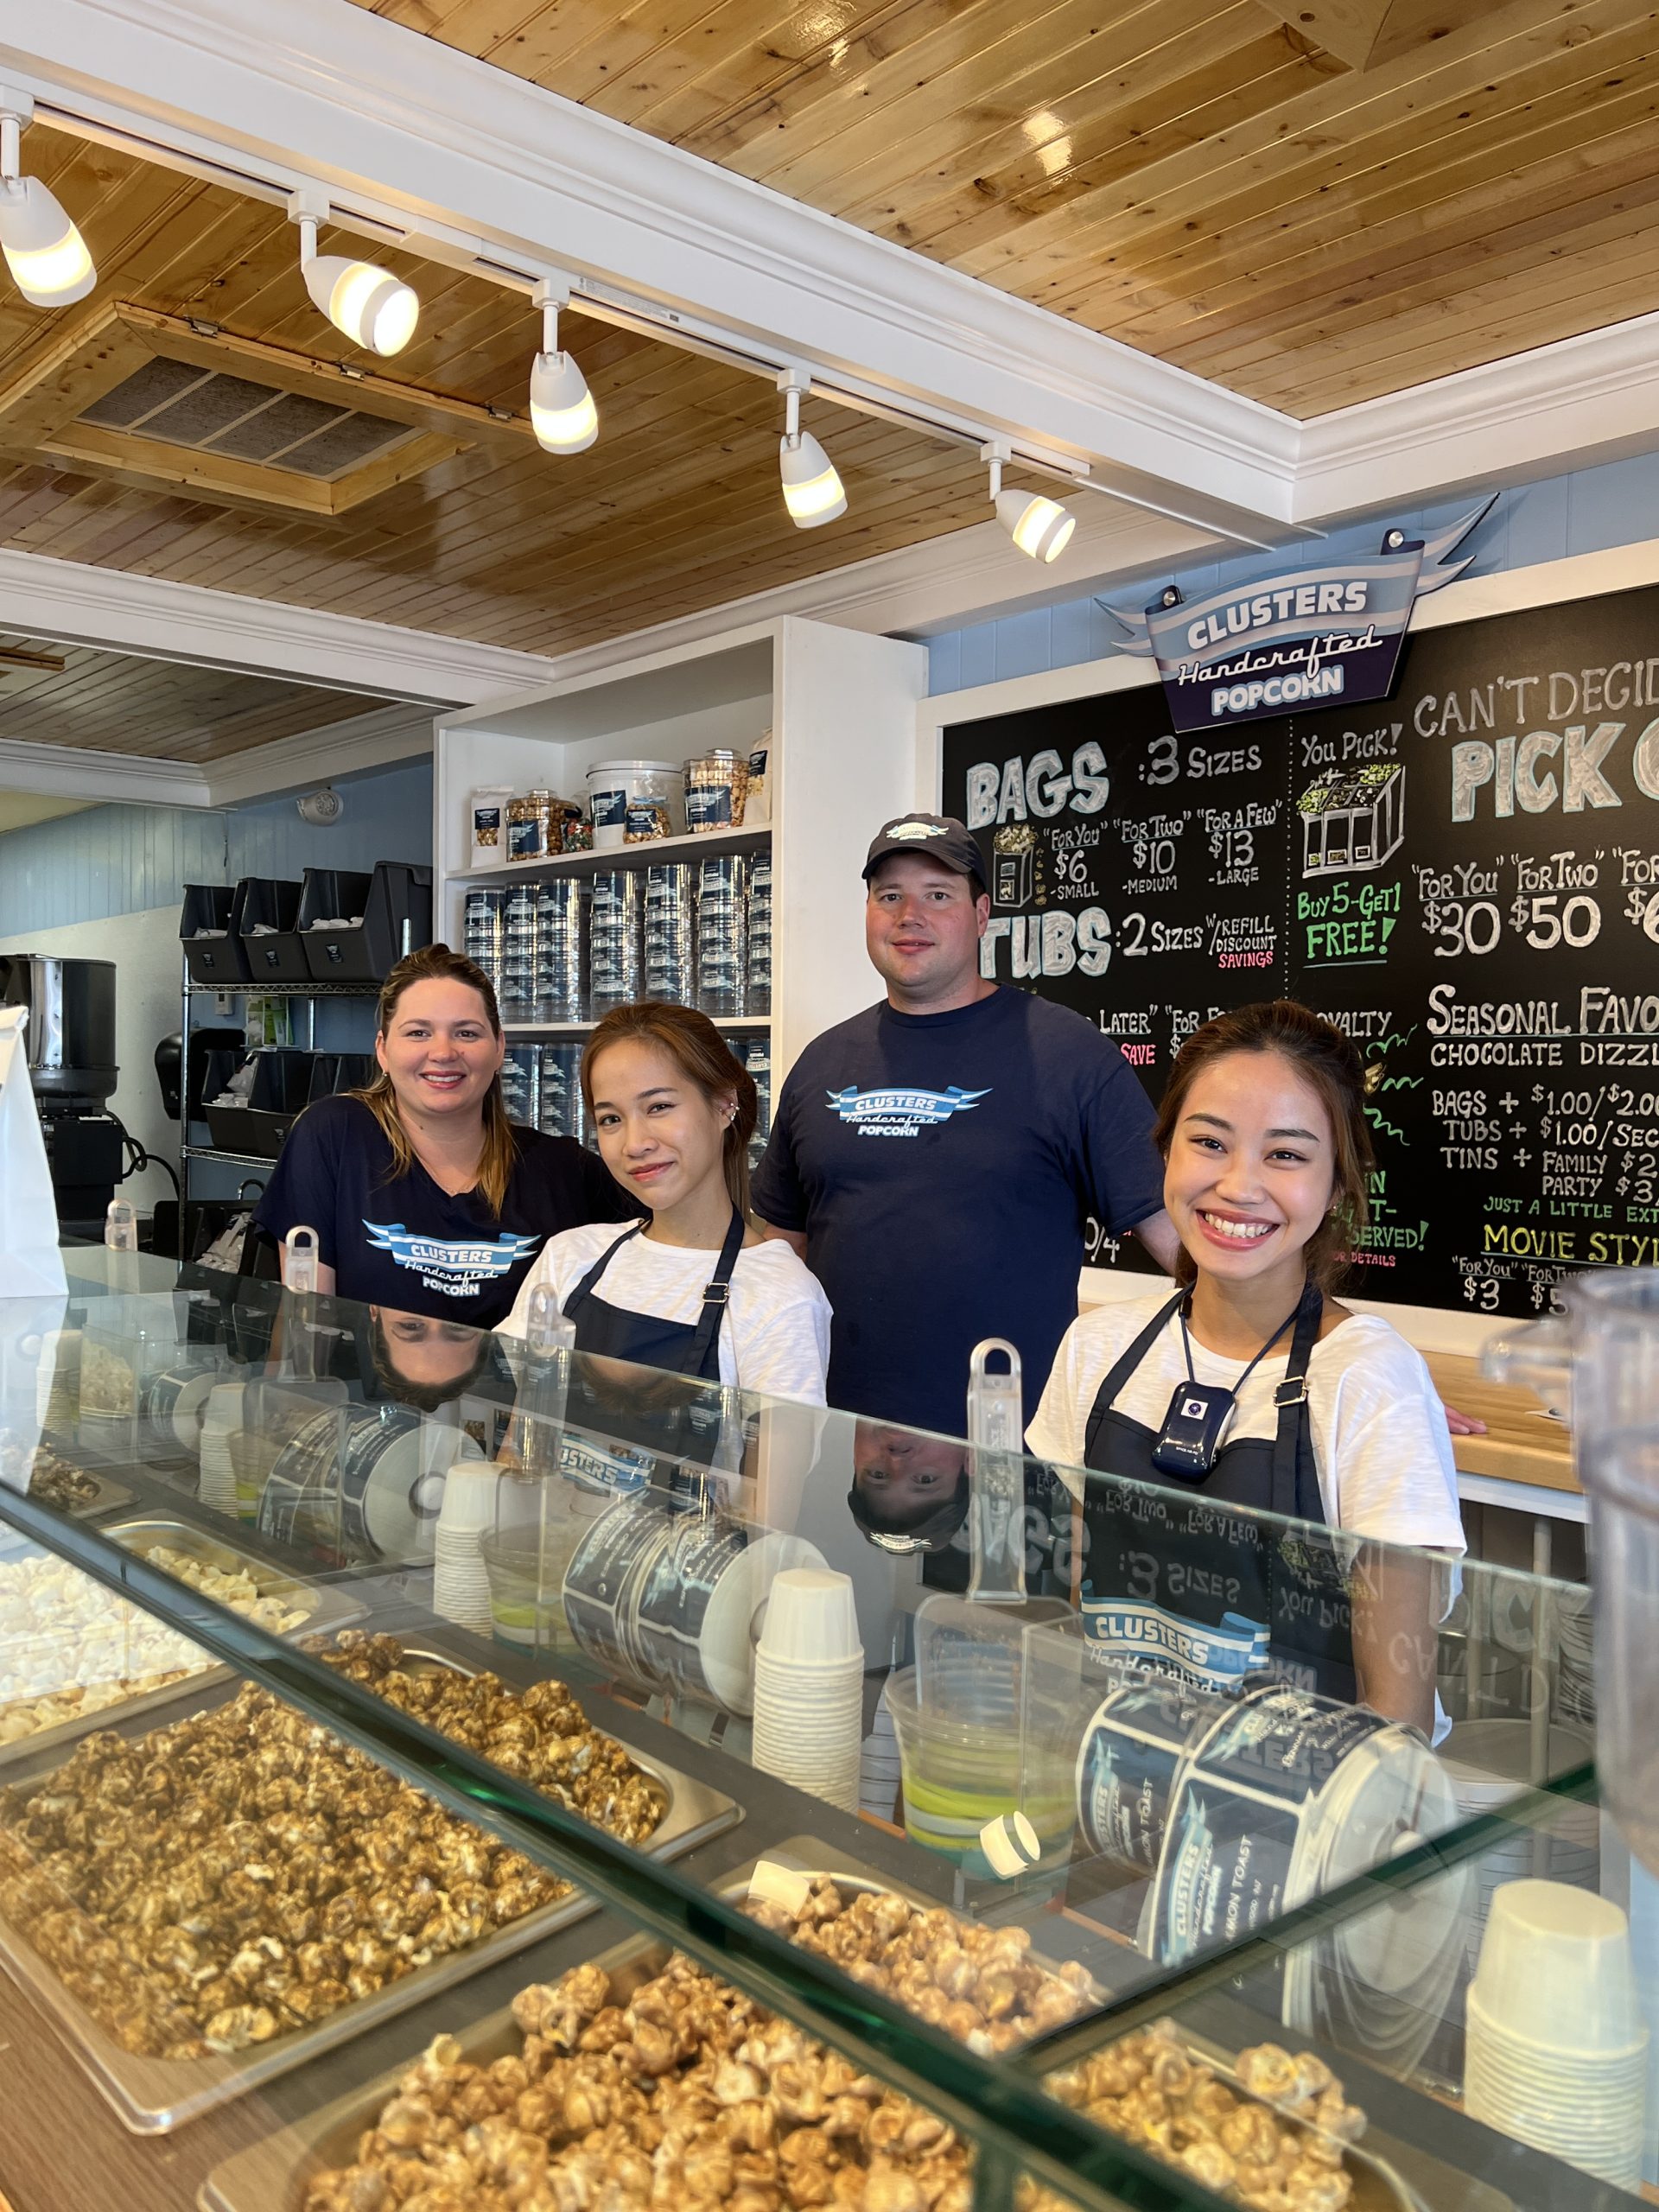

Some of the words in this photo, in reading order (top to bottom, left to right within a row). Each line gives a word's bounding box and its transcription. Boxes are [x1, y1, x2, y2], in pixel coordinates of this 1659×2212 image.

[1188, 582, 1368, 650] CLUSTERS
[1178, 625, 1382, 685] Handcrafted
[1211, 664, 1344, 716] POPCORN
[1414, 676, 1540, 737] CAN'T
[1343, 723, 1403, 760] PICK!
[1186, 746, 1262, 778] SIZES
[1452, 721, 1626, 823] PICK
[967, 741, 1109, 830] BAGS
[1233, 810, 1243, 826] A
[1054, 849, 1087, 882] $6
[1133, 840, 1176, 874] $10
[1209, 830, 1254, 868] $13
[1298, 892, 1329, 920] BUY
[1509, 894, 1601, 950] $50
[980, 906, 1111, 979] TUBS
[1151, 921, 1204, 952] SIZES
[1216, 935, 1277, 953] DISCOUNT
[1306, 917, 1396, 959] FREE!
[1421, 900, 1501, 957] $30
[1218, 951, 1274, 969] SAVINGS
[1317, 1011, 1392, 1037] YALTY
[1427, 984, 1571, 1035] SEASONAL
[1121, 1043, 1156, 1065] SAVE
[1430, 1042, 1562, 1067] CHOCOLATE
[855, 1096, 938, 1111] CLUSTERS
[1432, 1090, 1486, 1118] BAGS
[845, 1114, 938, 1128] Handcrafted
[857, 1124, 919, 1136] POPCORN
[1443, 1120, 1502, 1141] TUBS
[1440, 1147, 1498, 1169] TINS
[1542, 1150, 1608, 1174] FAMILY
[1541, 1176, 1603, 1197] PARTY
[1484, 1196, 1522, 1213] JUST
[1529, 1199, 1540, 1215] A
[1550, 1200, 1612, 1218] LITTLE
[410, 1244, 493, 1263] CLUSTERS
[1484, 1224, 1576, 1259] MOVIE
[404, 1259, 499, 1287] Handcrafted
[1351, 1252, 1396, 1267] DETAILS
[423, 1275, 480, 1296] POPCORN
[1464, 1276, 1499, 1310] $3
[1530, 1282, 1569, 1316] $5
[560, 1446, 618, 1485] USTERS
[1096, 1616, 1209, 1665] CLUSTERS
[1232, 1834, 1253, 1889] TOAST
[1176, 1842, 1199, 1937] CLUSTERS
